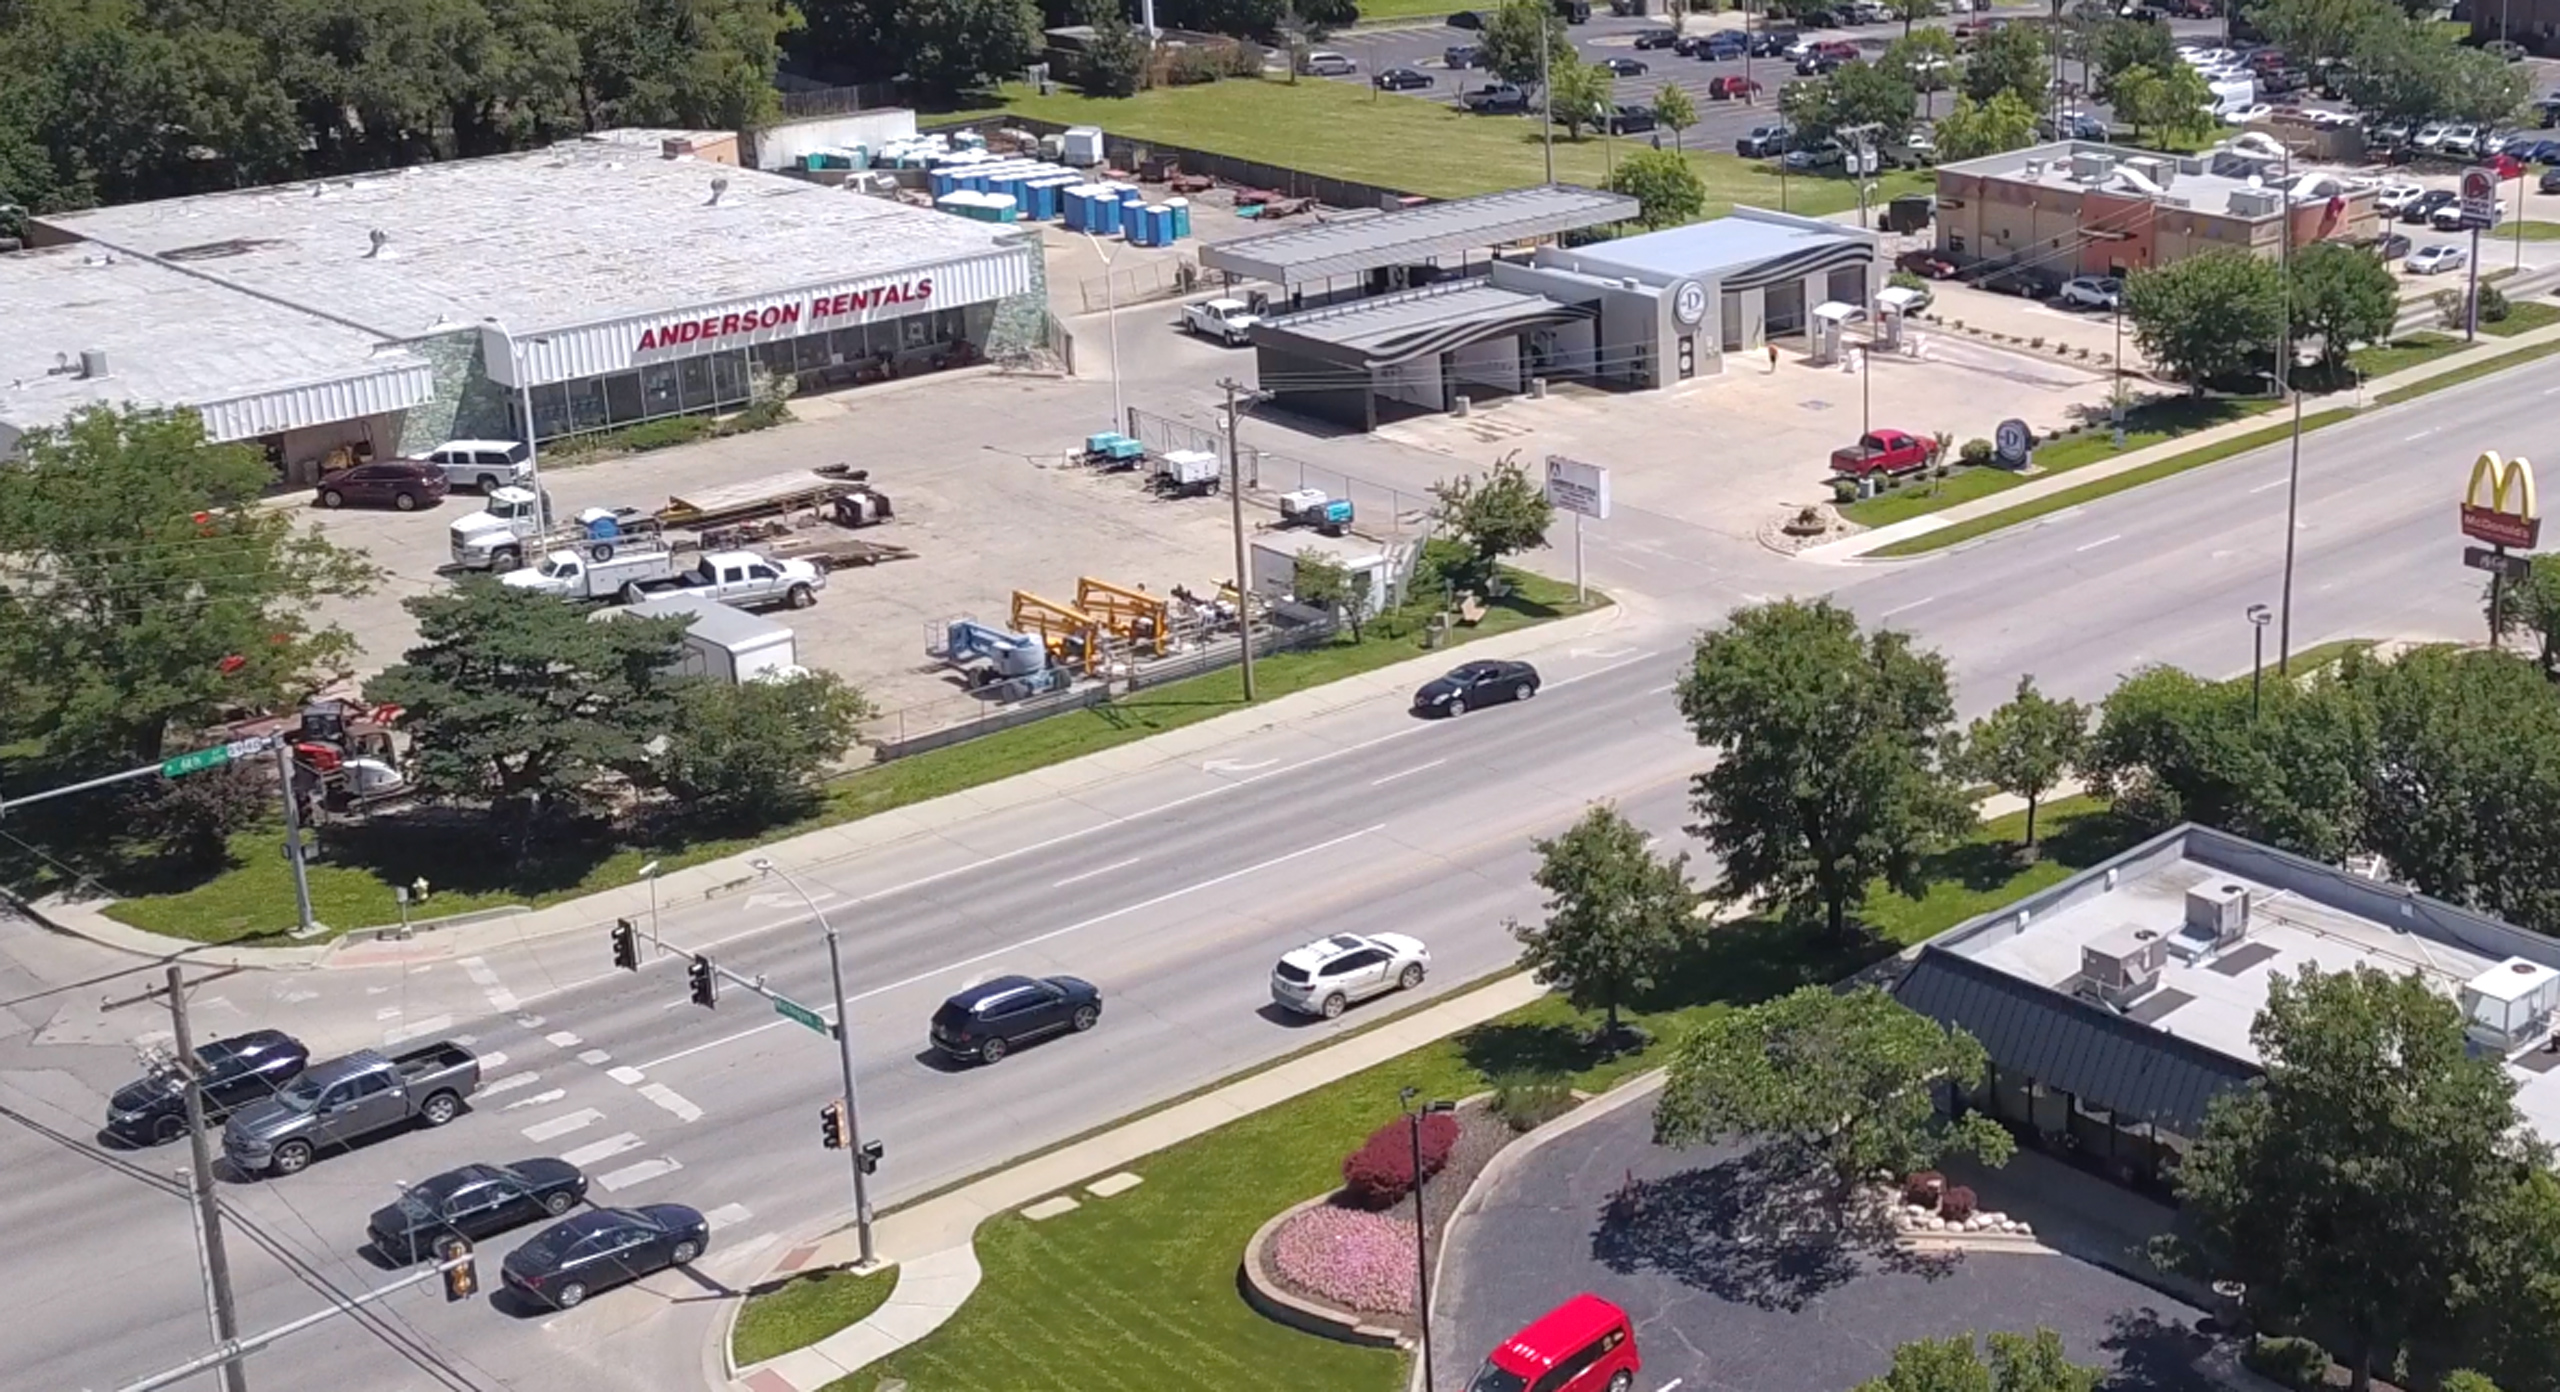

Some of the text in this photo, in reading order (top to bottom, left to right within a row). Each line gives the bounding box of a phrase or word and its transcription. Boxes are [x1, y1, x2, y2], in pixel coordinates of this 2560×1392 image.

[637, 278, 933, 352] ANDERSON RENTALS
[2464, 514, 2530, 539] McDonald's
